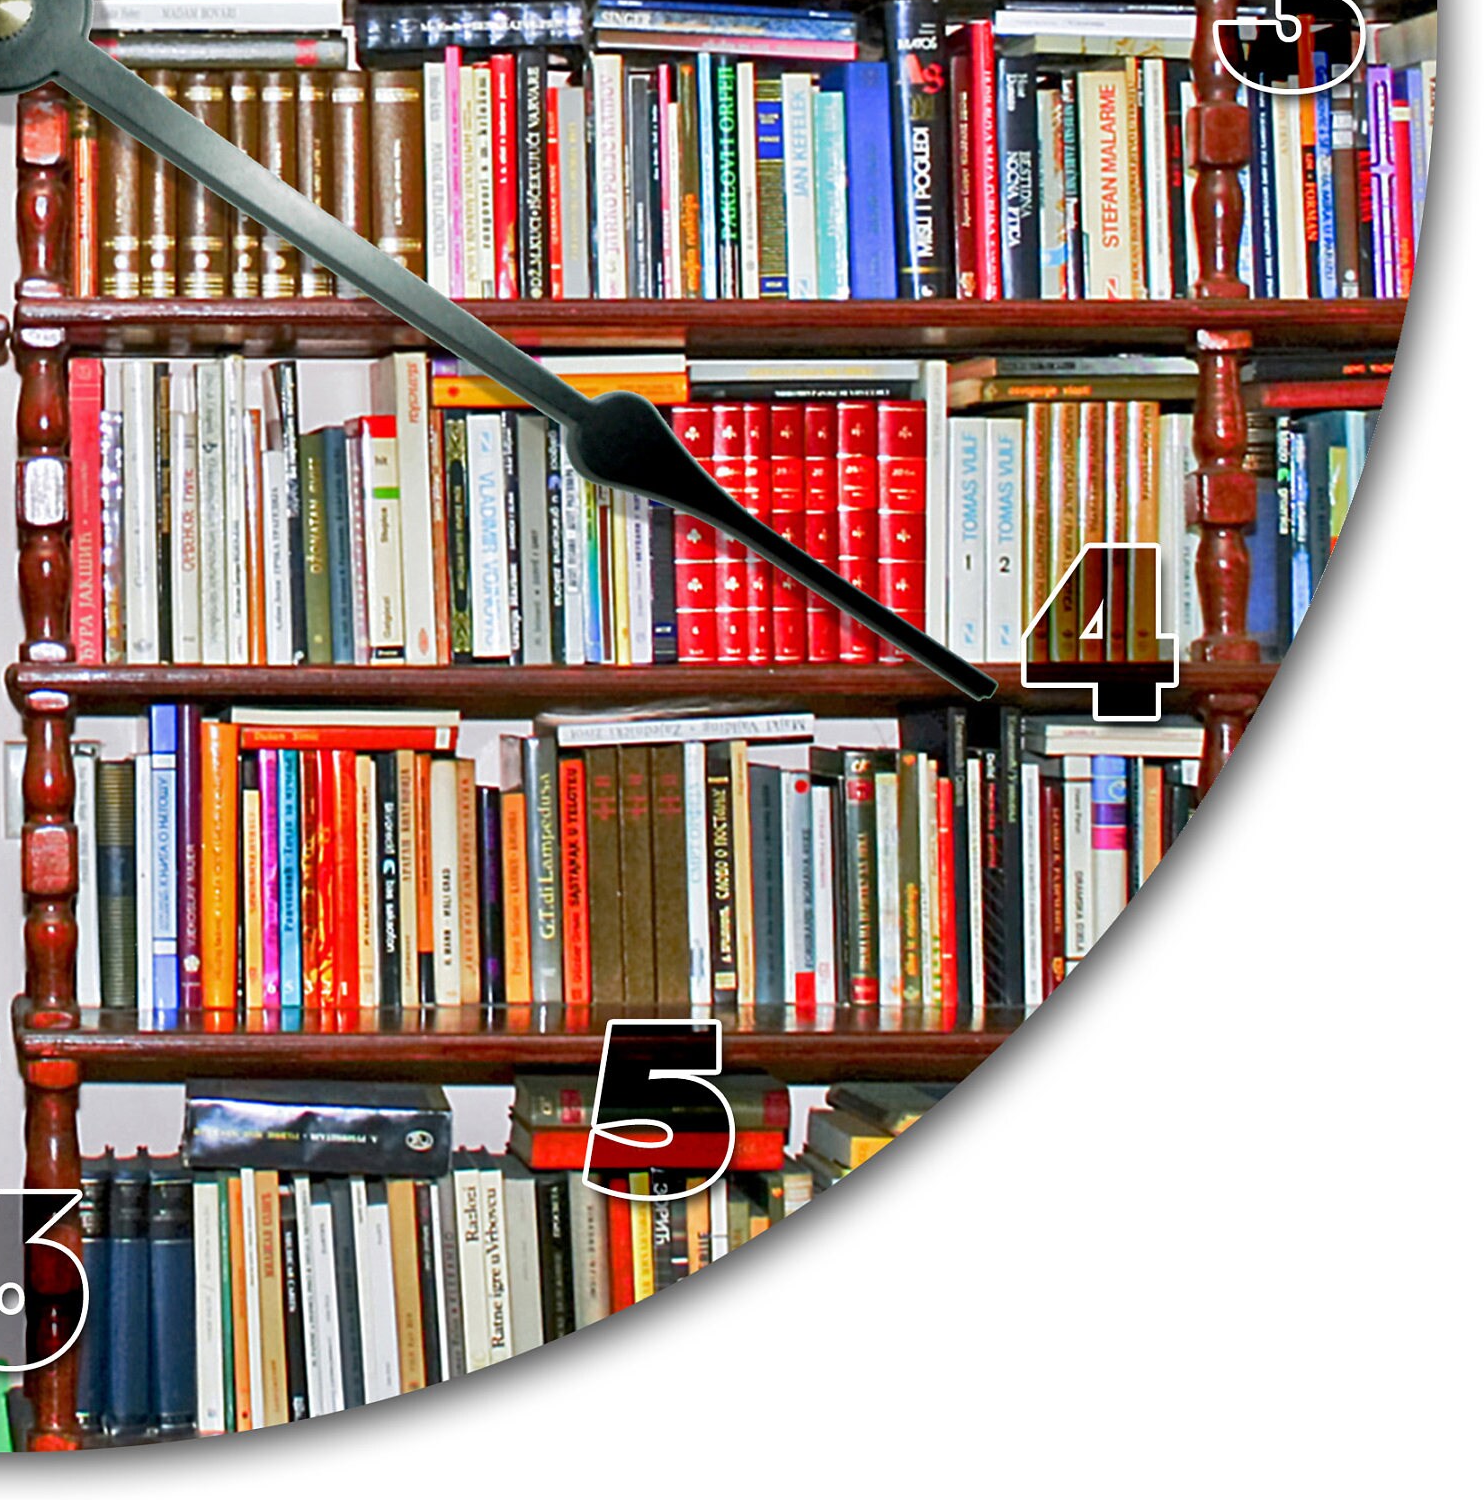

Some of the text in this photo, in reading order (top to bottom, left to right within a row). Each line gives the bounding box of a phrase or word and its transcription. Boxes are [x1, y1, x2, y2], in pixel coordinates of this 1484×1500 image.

[526, 66, 541, 128] VARVARE
[791, 90, 808, 197] JAN KEFELEK
[719, 145, 737, 241] PAKLOVI
[913, 127, 933, 258] MISLI POGLEDI
[1100, 84, 1119, 248] STEFAN MALARME
[478, 471, 499, 556] VLADIMIR
[961, 431, 978, 543] TOMAS VULF
[998, 434, 1014, 545] TOMAS VULF
[78, 531, 95, 661] ЂУРА ЈАКШИЋ
[965, 554, 971, 570] 1
[999, 556, 1010, 573] 2
[1021, 543, 1179, 721] 4
[536, 773, 554, 883] Lampedusa
[569, 840, 579, 907] SASTANAK
[185, 885, 197, 947] VJEKOSLAV
[582, 1018, 735, 1200] 5
[464, 1186, 480, 1243] Razlozi
[483, 1187, 505, 1348] Ratne igre Vrbovcu
